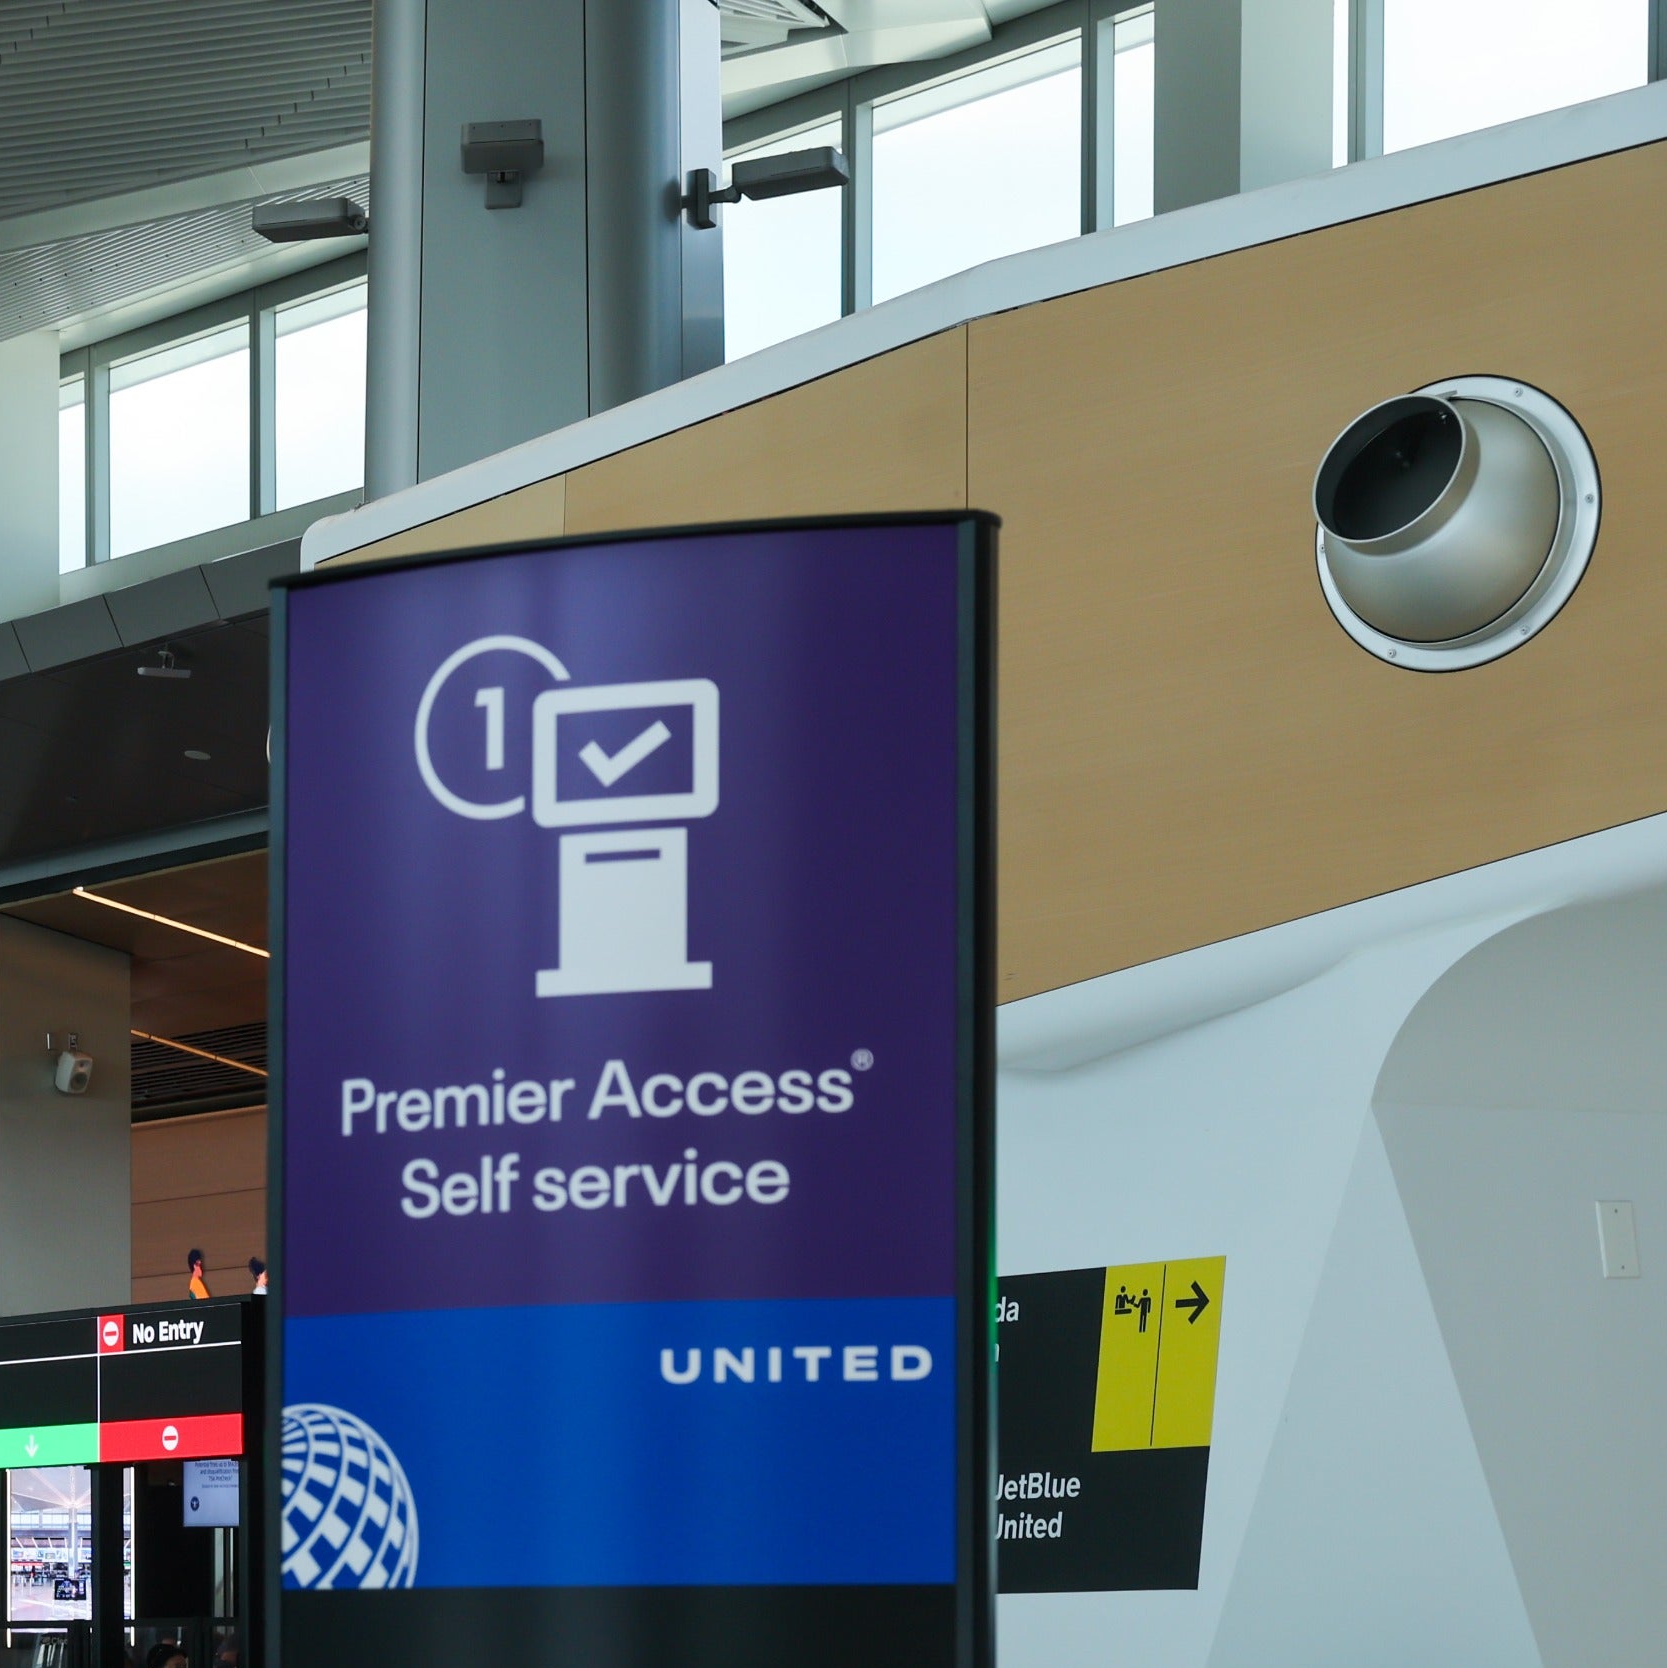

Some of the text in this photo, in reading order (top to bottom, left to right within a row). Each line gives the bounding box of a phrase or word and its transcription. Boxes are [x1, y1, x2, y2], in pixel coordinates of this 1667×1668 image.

[474, 687, 504, 770] 1
[341, 1067, 573, 1136] Premier
[401, 1148, 790, 1219] Self service
[132, 1319, 204, 1344] No Entry
[659, 1344, 933, 1384] UNITED
[995, 1472, 1080, 1501] JetBlue
